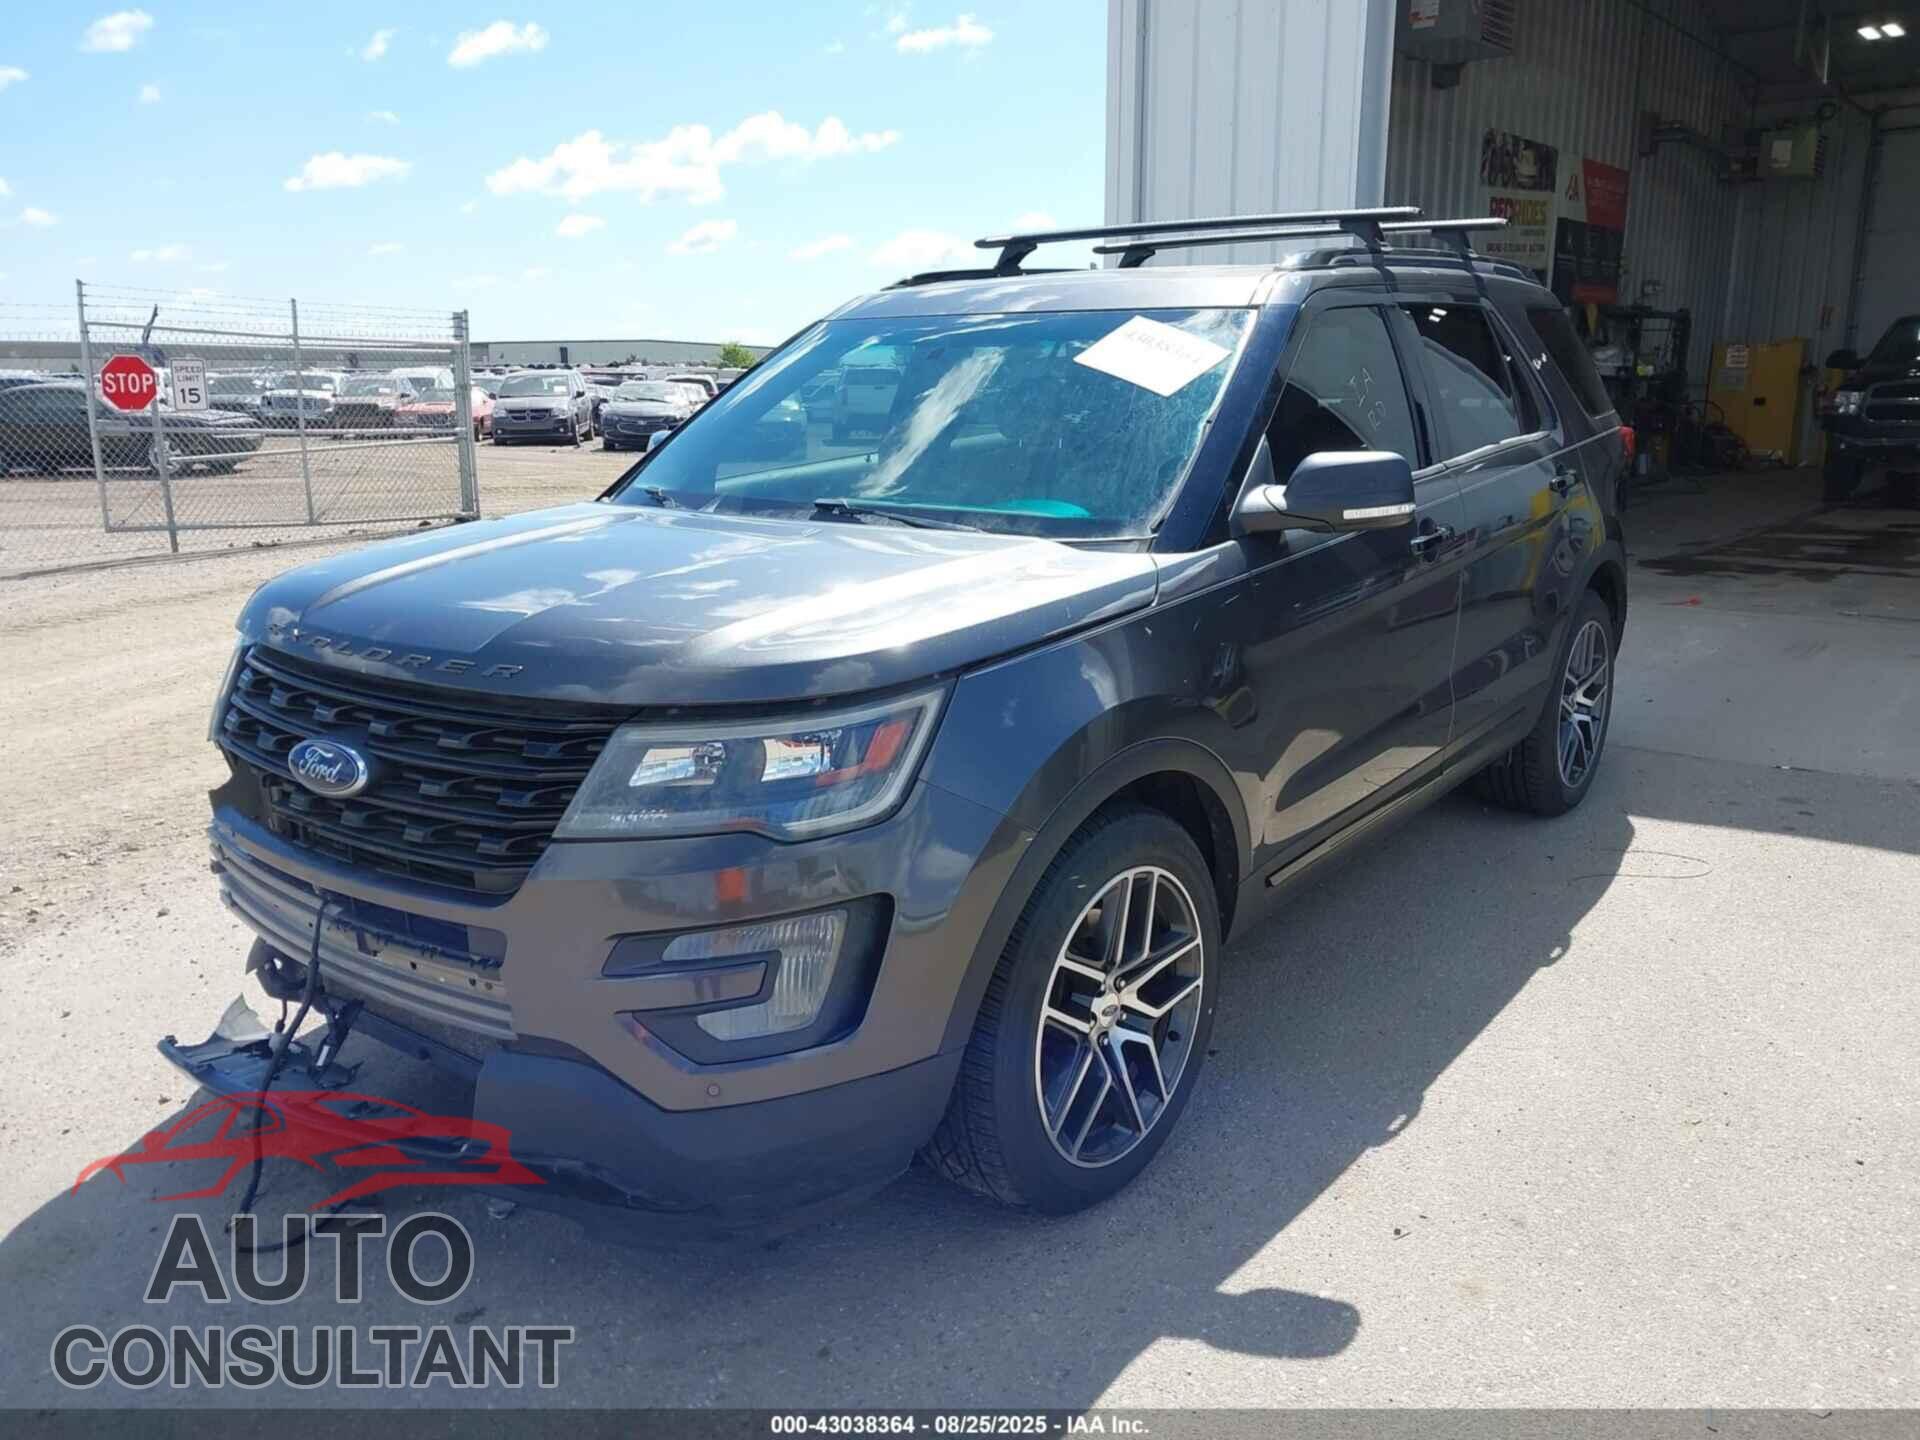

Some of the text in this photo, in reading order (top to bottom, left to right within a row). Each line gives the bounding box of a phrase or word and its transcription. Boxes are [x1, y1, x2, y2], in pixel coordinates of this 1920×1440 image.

[174, 365, 201, 373] SPEED
[104, 373, 153, 393] STOP
[180, 387, 200, 404] 15
[299, 747, 343, 783] Ford
